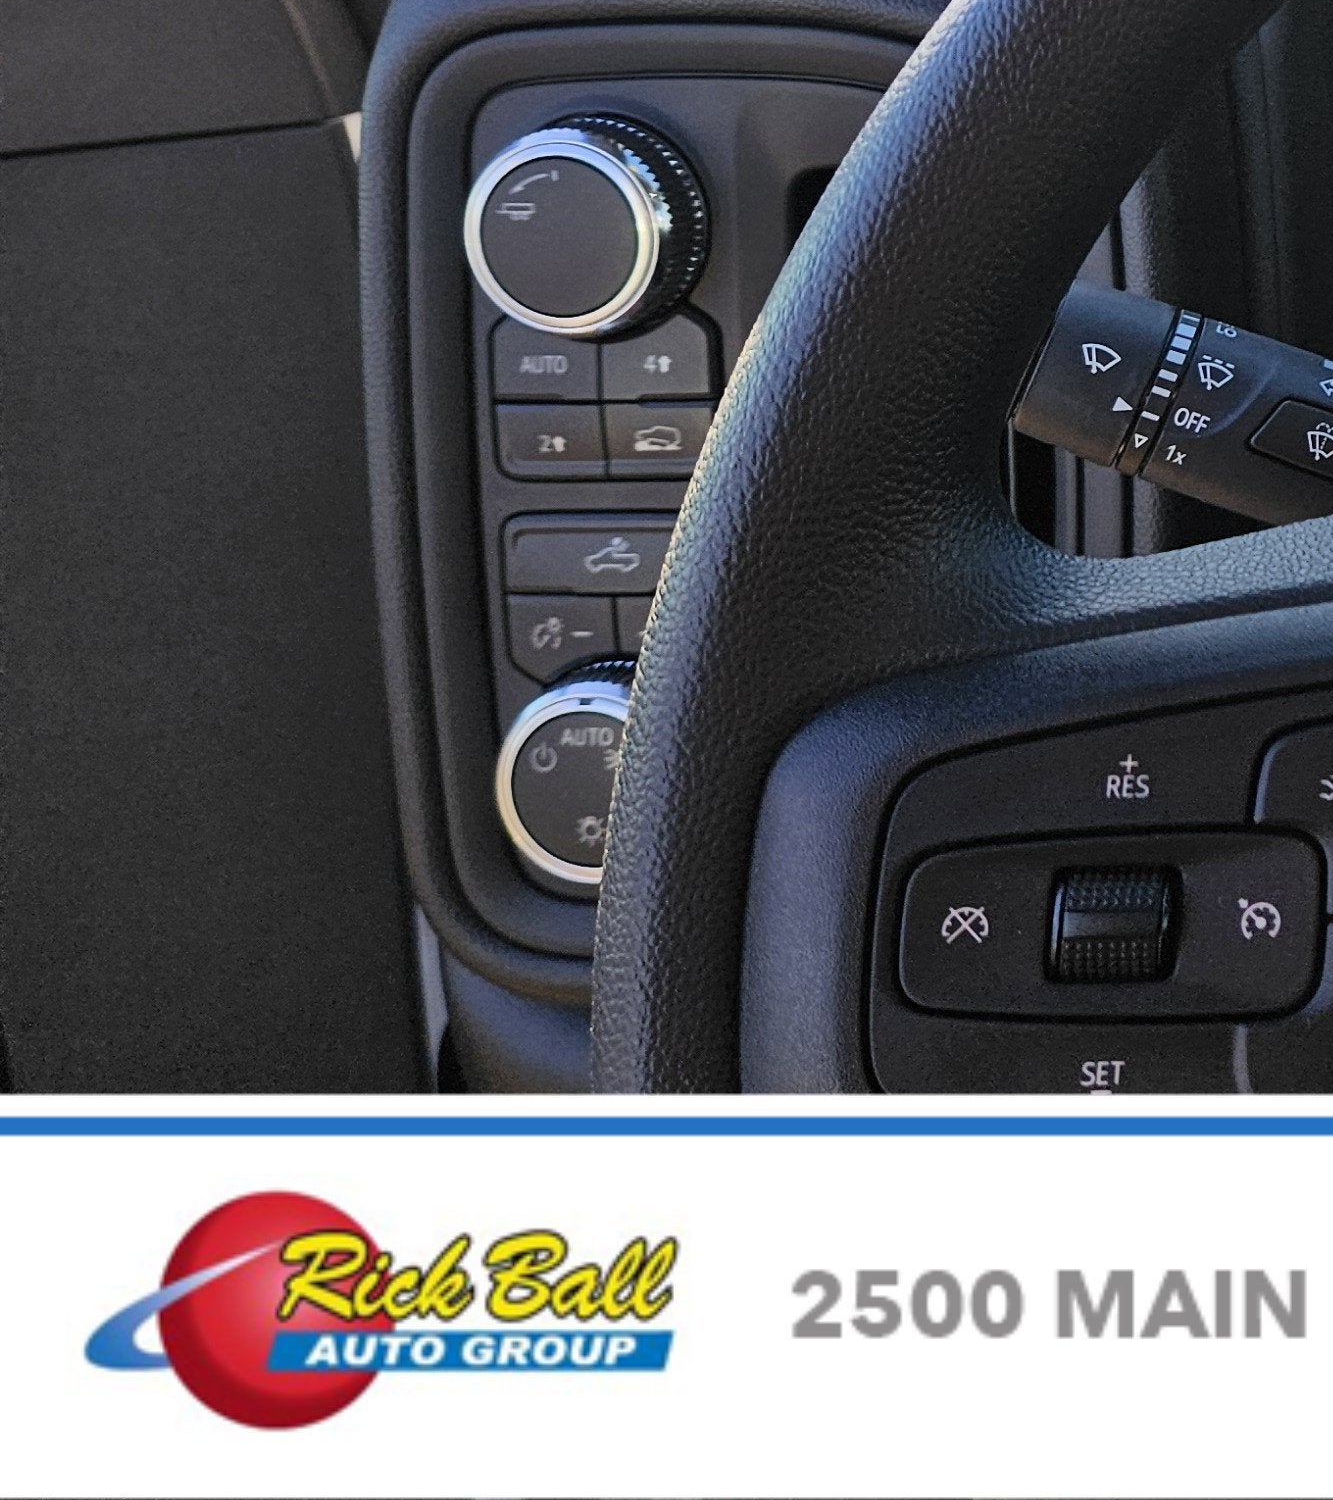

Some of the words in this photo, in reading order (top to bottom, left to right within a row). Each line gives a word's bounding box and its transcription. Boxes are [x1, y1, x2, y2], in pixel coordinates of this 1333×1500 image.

[519, 355, 568, 375] AUTO
[1173, 407, 1211, 434] OFF
[1165, 444, 1187, 466] 1x
[560, 726, 614, 747] AUTO
[1105, 774, 1150, 799] RES
[1079, 1060, 1126, 1086] SET
